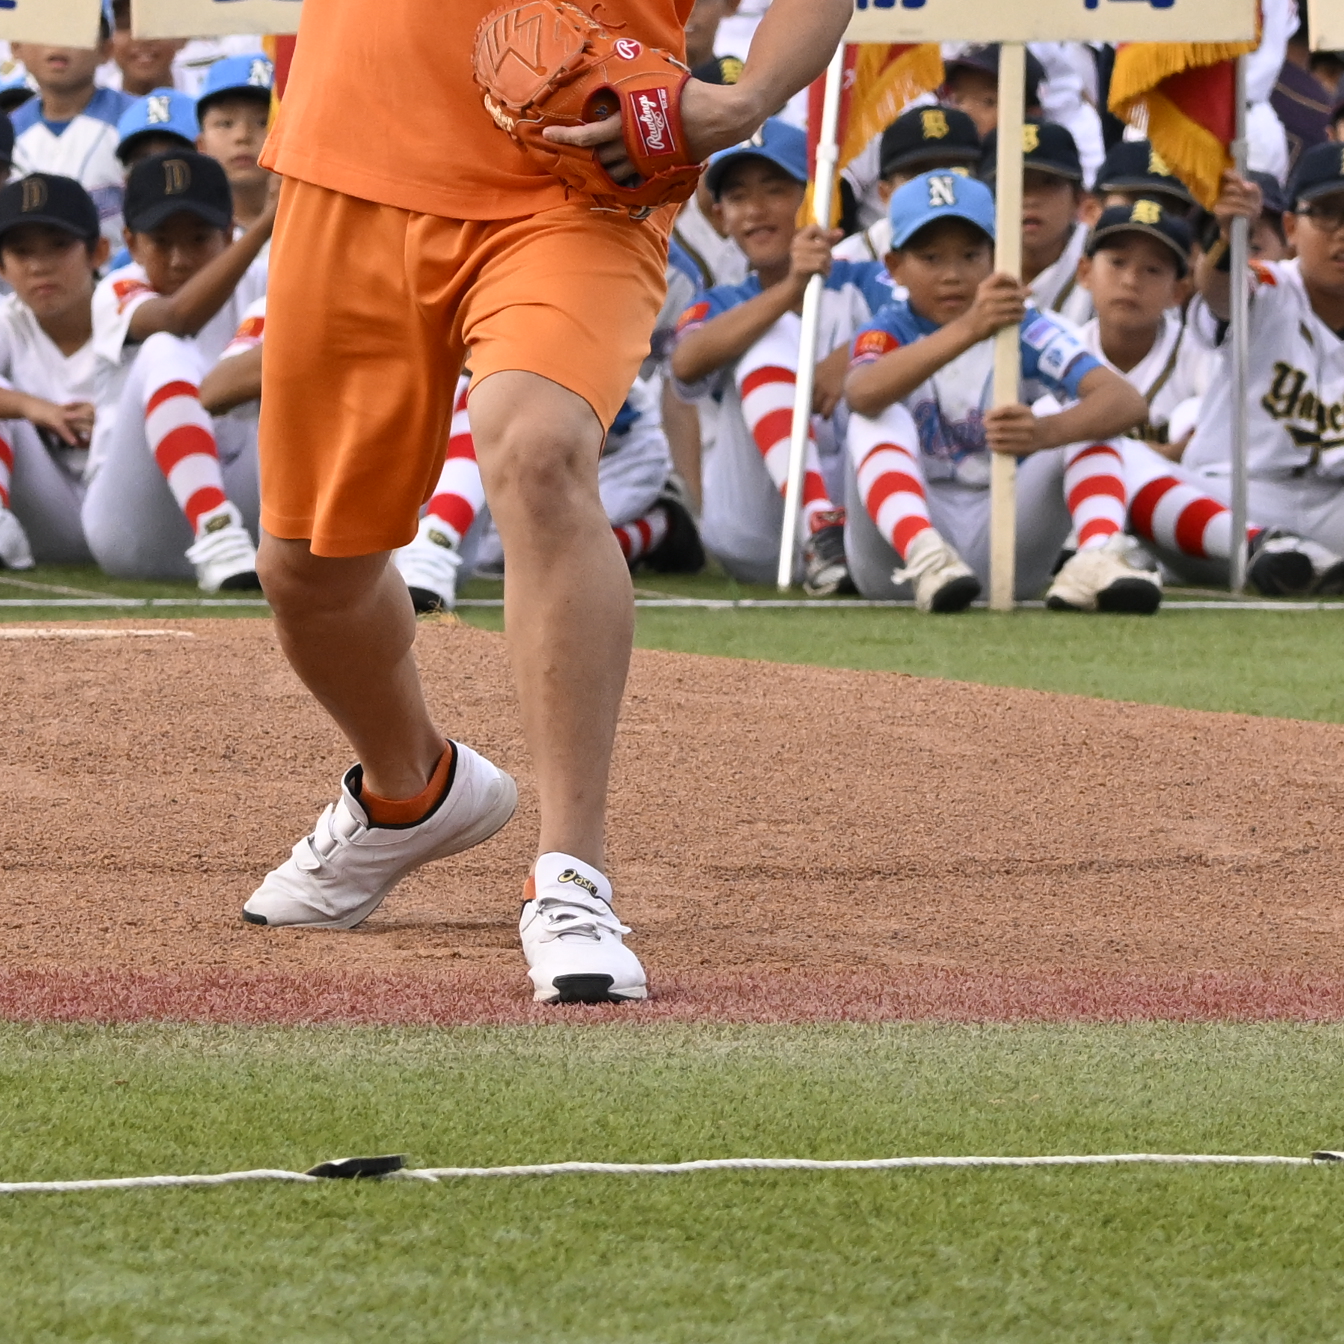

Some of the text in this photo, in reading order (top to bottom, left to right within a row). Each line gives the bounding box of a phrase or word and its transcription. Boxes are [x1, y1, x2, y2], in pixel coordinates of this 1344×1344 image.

[146, 97, 170, 124] N
[637, 93, 666, 150] Rawlings
[162, 158, 191, 196] D
[928, 175, 957, 207] N
